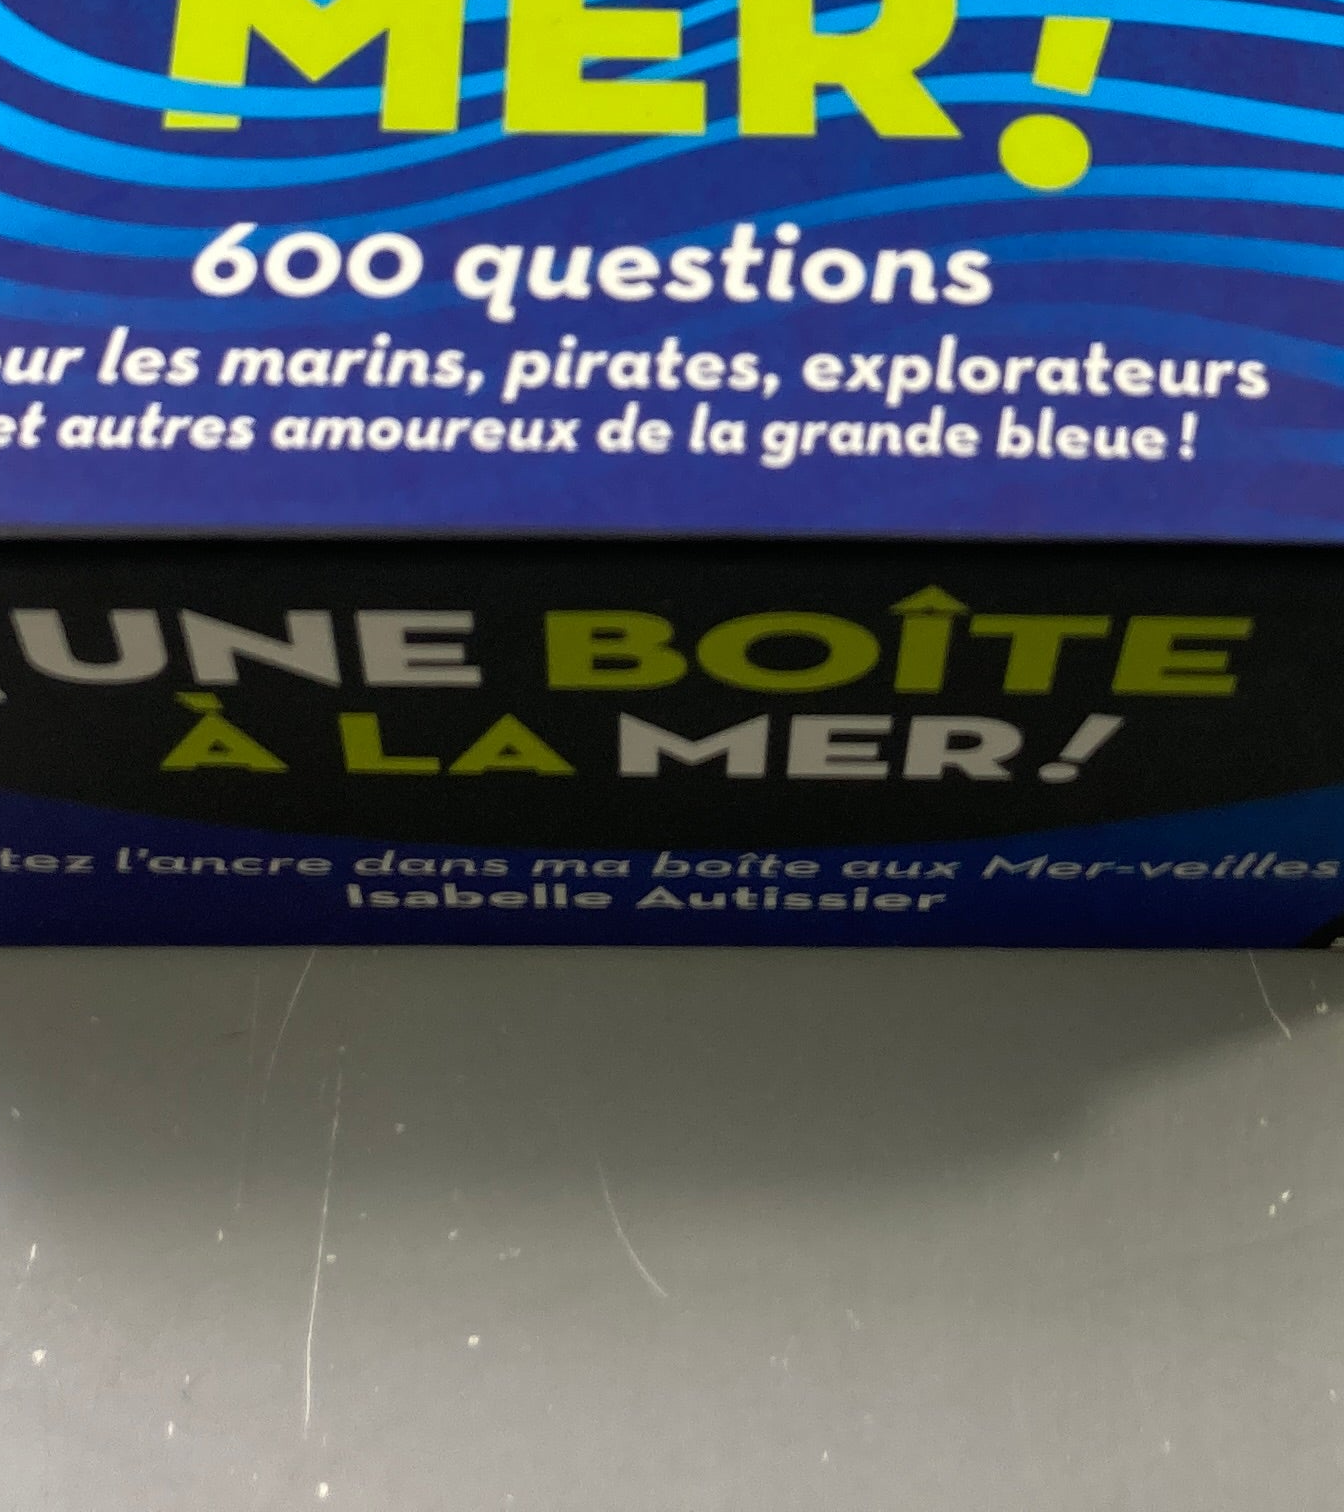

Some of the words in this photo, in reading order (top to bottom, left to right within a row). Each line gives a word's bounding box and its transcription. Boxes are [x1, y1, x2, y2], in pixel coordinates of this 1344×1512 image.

[191, 221, 425, 299] 600
[454, 222, 993, 323] questions
[97, 326, 201, 385] les
[218, 332, 484, 395] marins,
[500, 334, 780, 403] pirates,
[801, 334, 1271, 408] explorateurs
[57, 402, 256, 450] autres
[270, 404, 580, 453] amoureux
[596, 401, 672, 454] de
[689, 403, 747, 454] la
[760, 405, 981, 469] grande
[10, 607, 483, 687] UNE
[544, 585, 1254, 696] BOÎTE
[160, 691, 289, 773] À
[339, 711, 576, 775] LA
[116, 847, 333, 876] l'ancre
[353, 849, 509, 877] dans
[531, 856, 631, 878] ma
[651, 851, 821, 879] boîte
[840, 859, 959, 879] aux
[346, 882, 613, 909] Isabelle
[635, 884, 947, 912] Autissier
